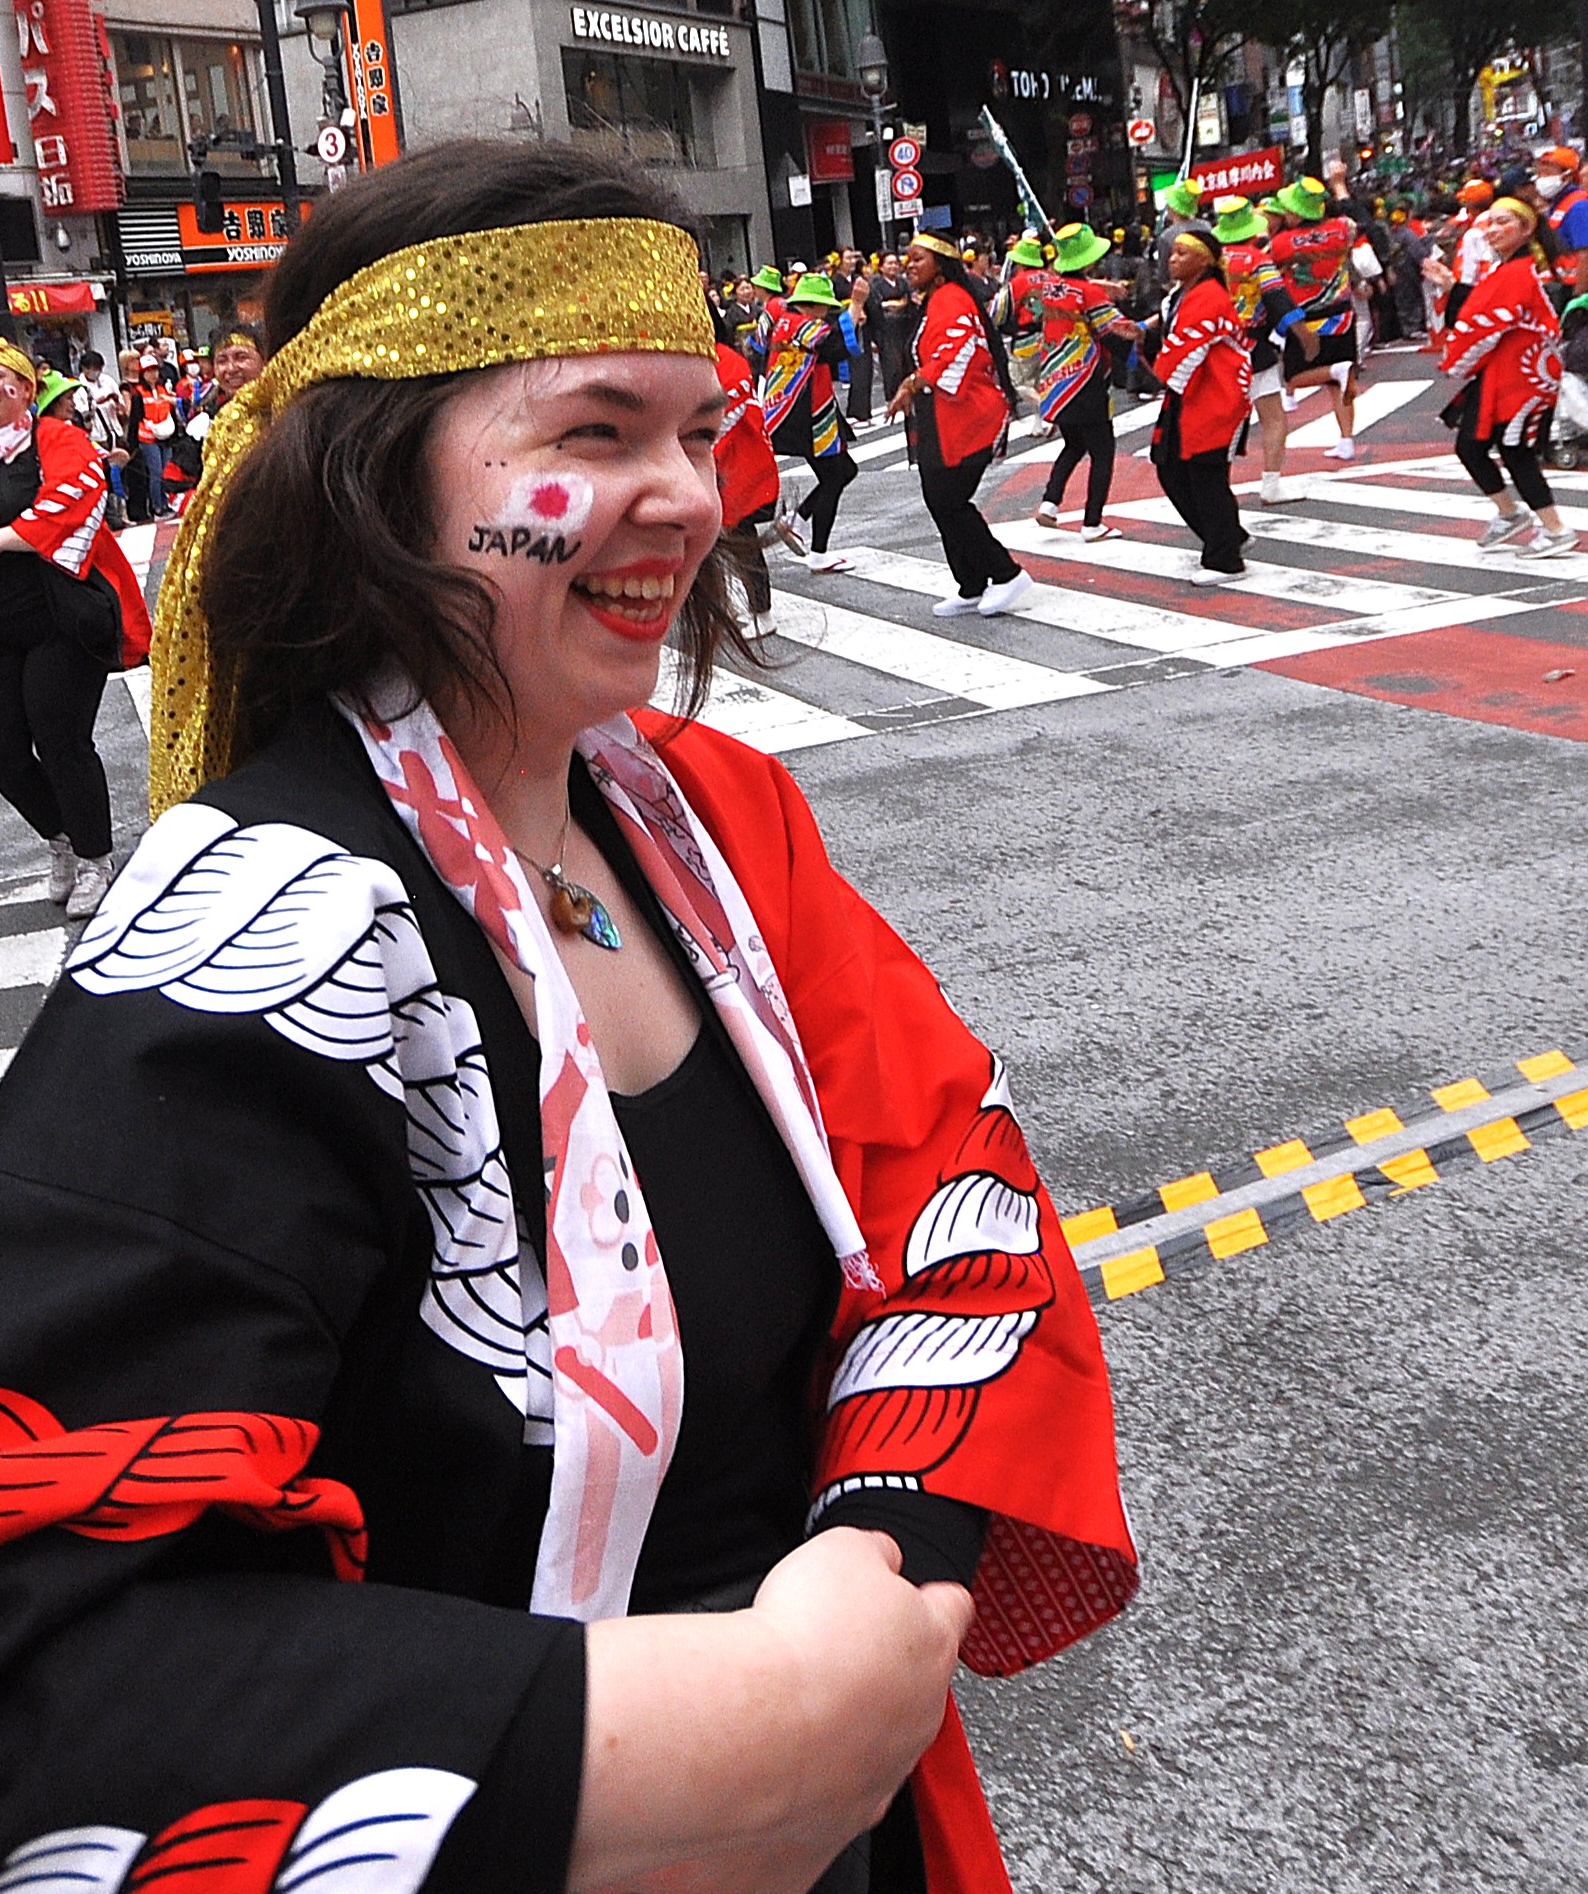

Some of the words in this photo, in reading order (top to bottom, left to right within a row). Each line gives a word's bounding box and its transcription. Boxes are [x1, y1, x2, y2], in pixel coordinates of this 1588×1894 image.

[572, 7, 675, 49] EXCELSIOR
[677, 26, 730, 56] CAFFÉ
[325, 133, 339, 157] 3
[897, 147, 912, 161] 40
[125, 252, 182, 267] YOSHINOYA
[226, 245, 285, 261] YOSHINOY
[469, 524, 582, 565] JAPAN
